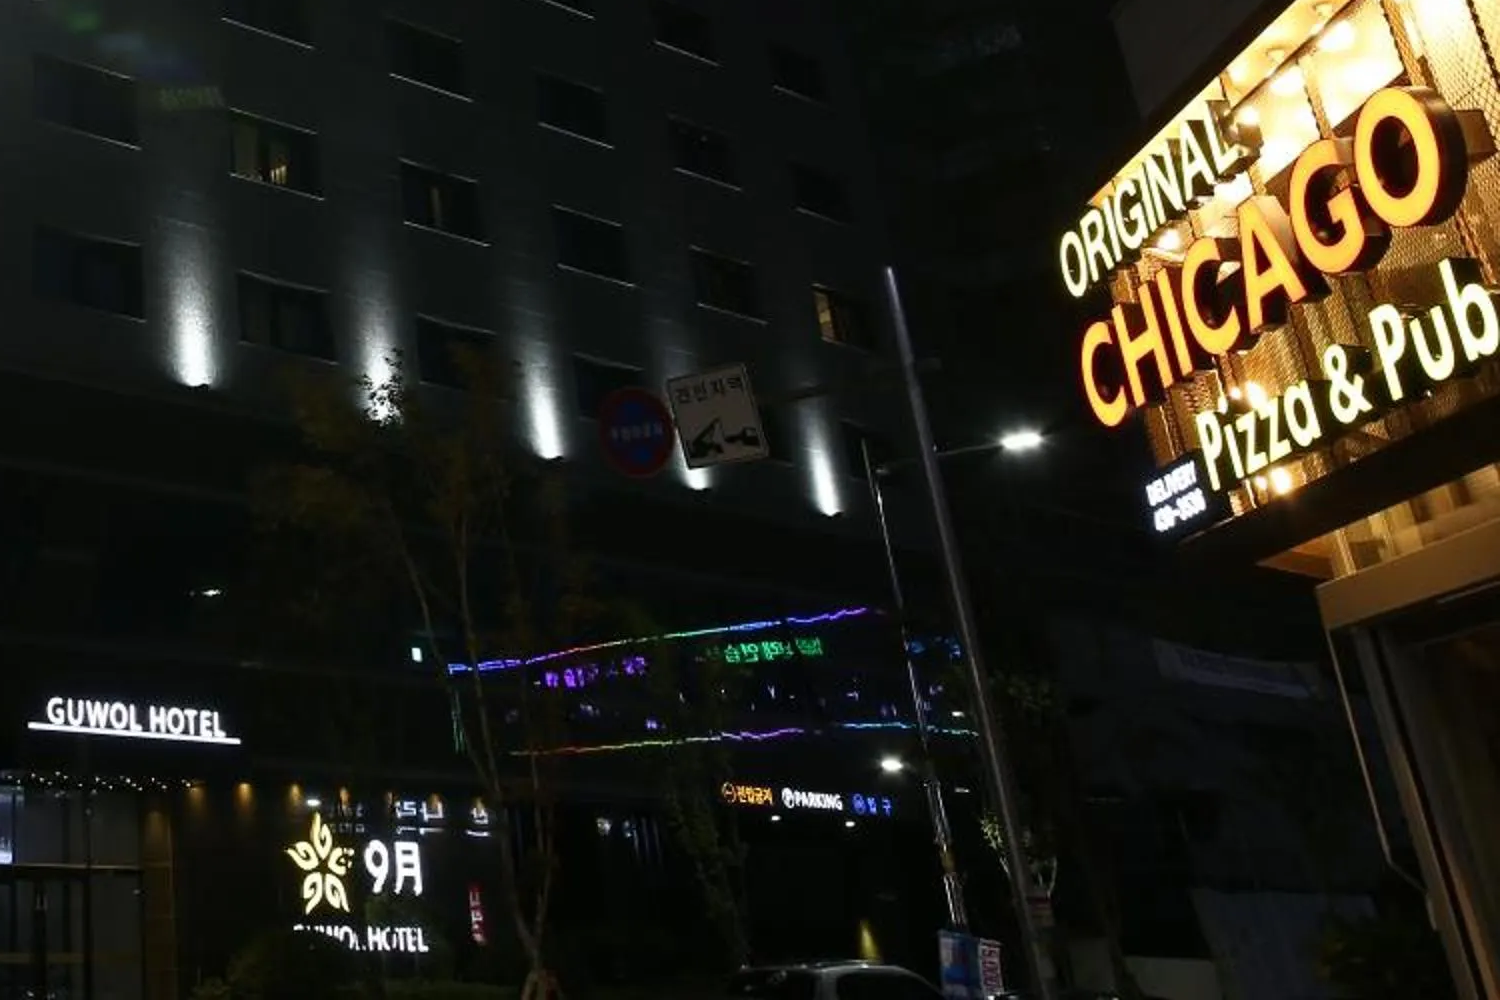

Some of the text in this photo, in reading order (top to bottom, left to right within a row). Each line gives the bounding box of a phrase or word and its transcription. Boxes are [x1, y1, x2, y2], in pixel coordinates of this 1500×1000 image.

[1058, 99, 1248, 299] ORIGINAL
[1080, 86, 1445, 429] CHICAGO
[674, 376, 743, 404] 견인지역
[1194, 257, 1500, 492] Pizza & Pub
[45, 696, 228, 740] GUWOL HOTEL
[794, 790, 844, 812] PARKING
